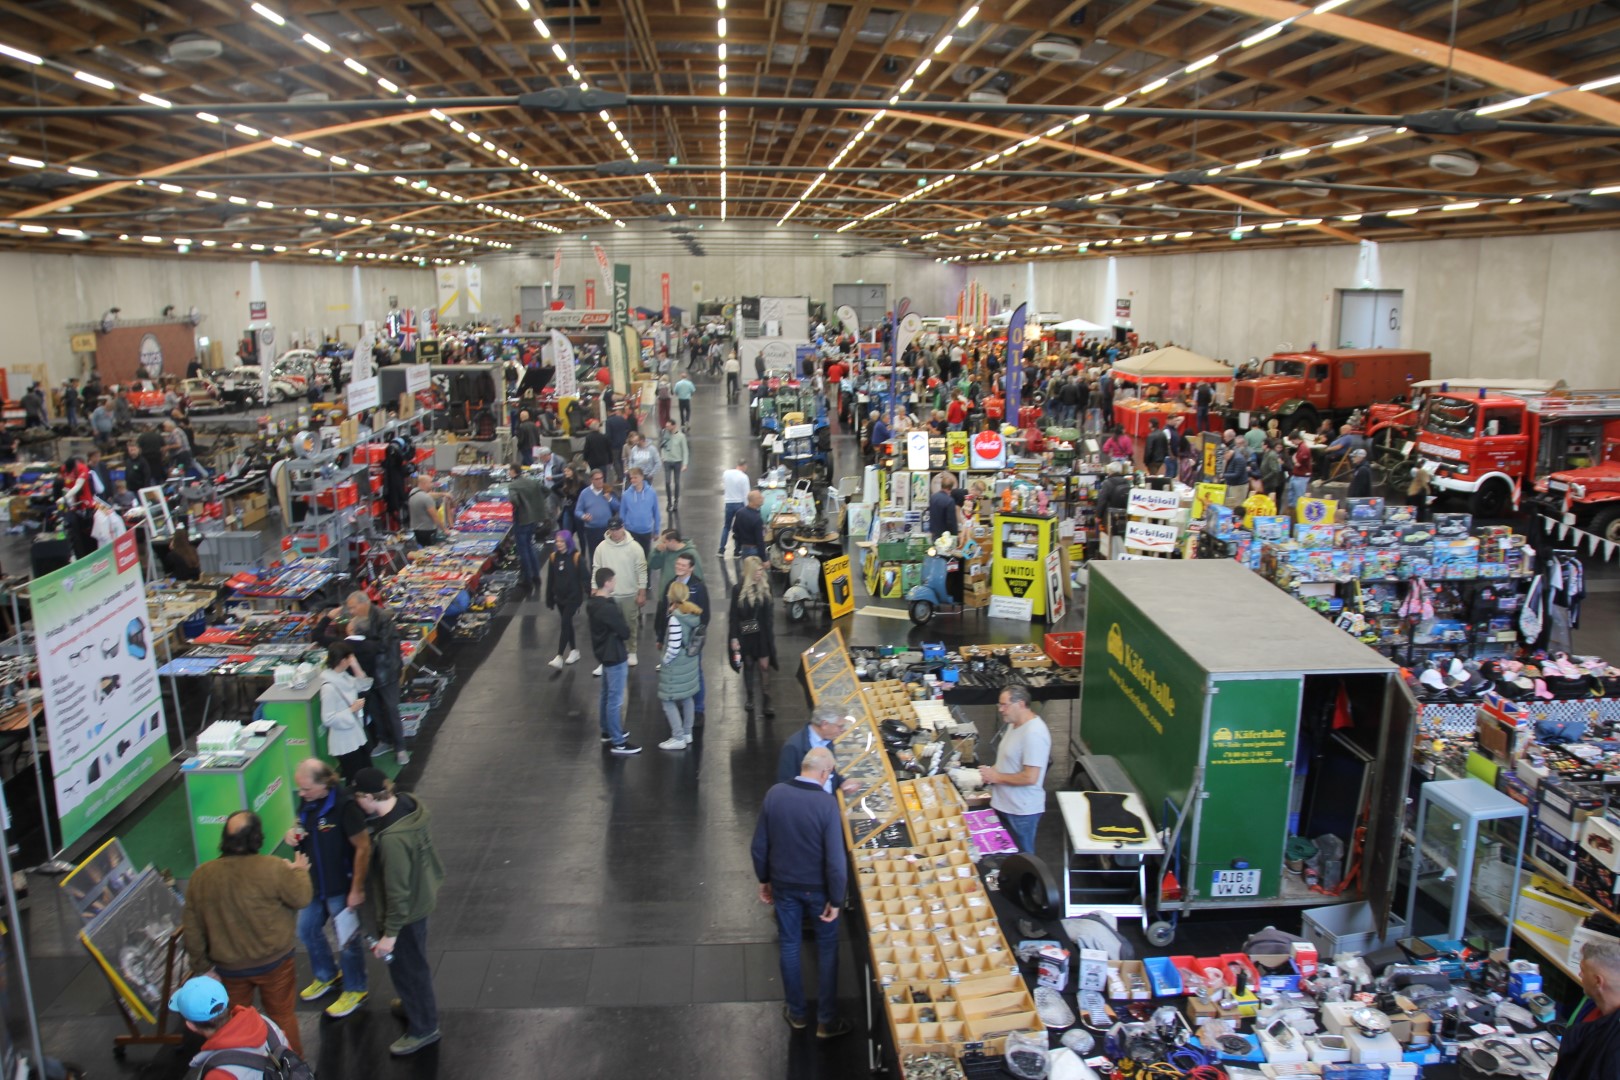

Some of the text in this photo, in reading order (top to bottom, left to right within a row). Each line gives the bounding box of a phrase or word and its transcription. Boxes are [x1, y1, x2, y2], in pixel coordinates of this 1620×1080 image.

[616, 281, 628, 333] JAGUA
[975, 440, 1001, 451] Coca-Cola
[1131, 493, 1177, 507] Mobiloil
[1247, 508, 1276, 517] HELL
[1129, 526, 1174, 540] Mobiloil
[824, 559, 850, 575] Banner
[1003, 565, 1036, 577] UNITOL
[1008, 580, 1029, 588] MOTOR
[1124, 643, 1175, 717] Käferhalle
[1233, 728, 1287, 740] Käferhalle
[1220, 872, 1244, 884] AIB
[1218, 883, 1253, 895] VW 66
